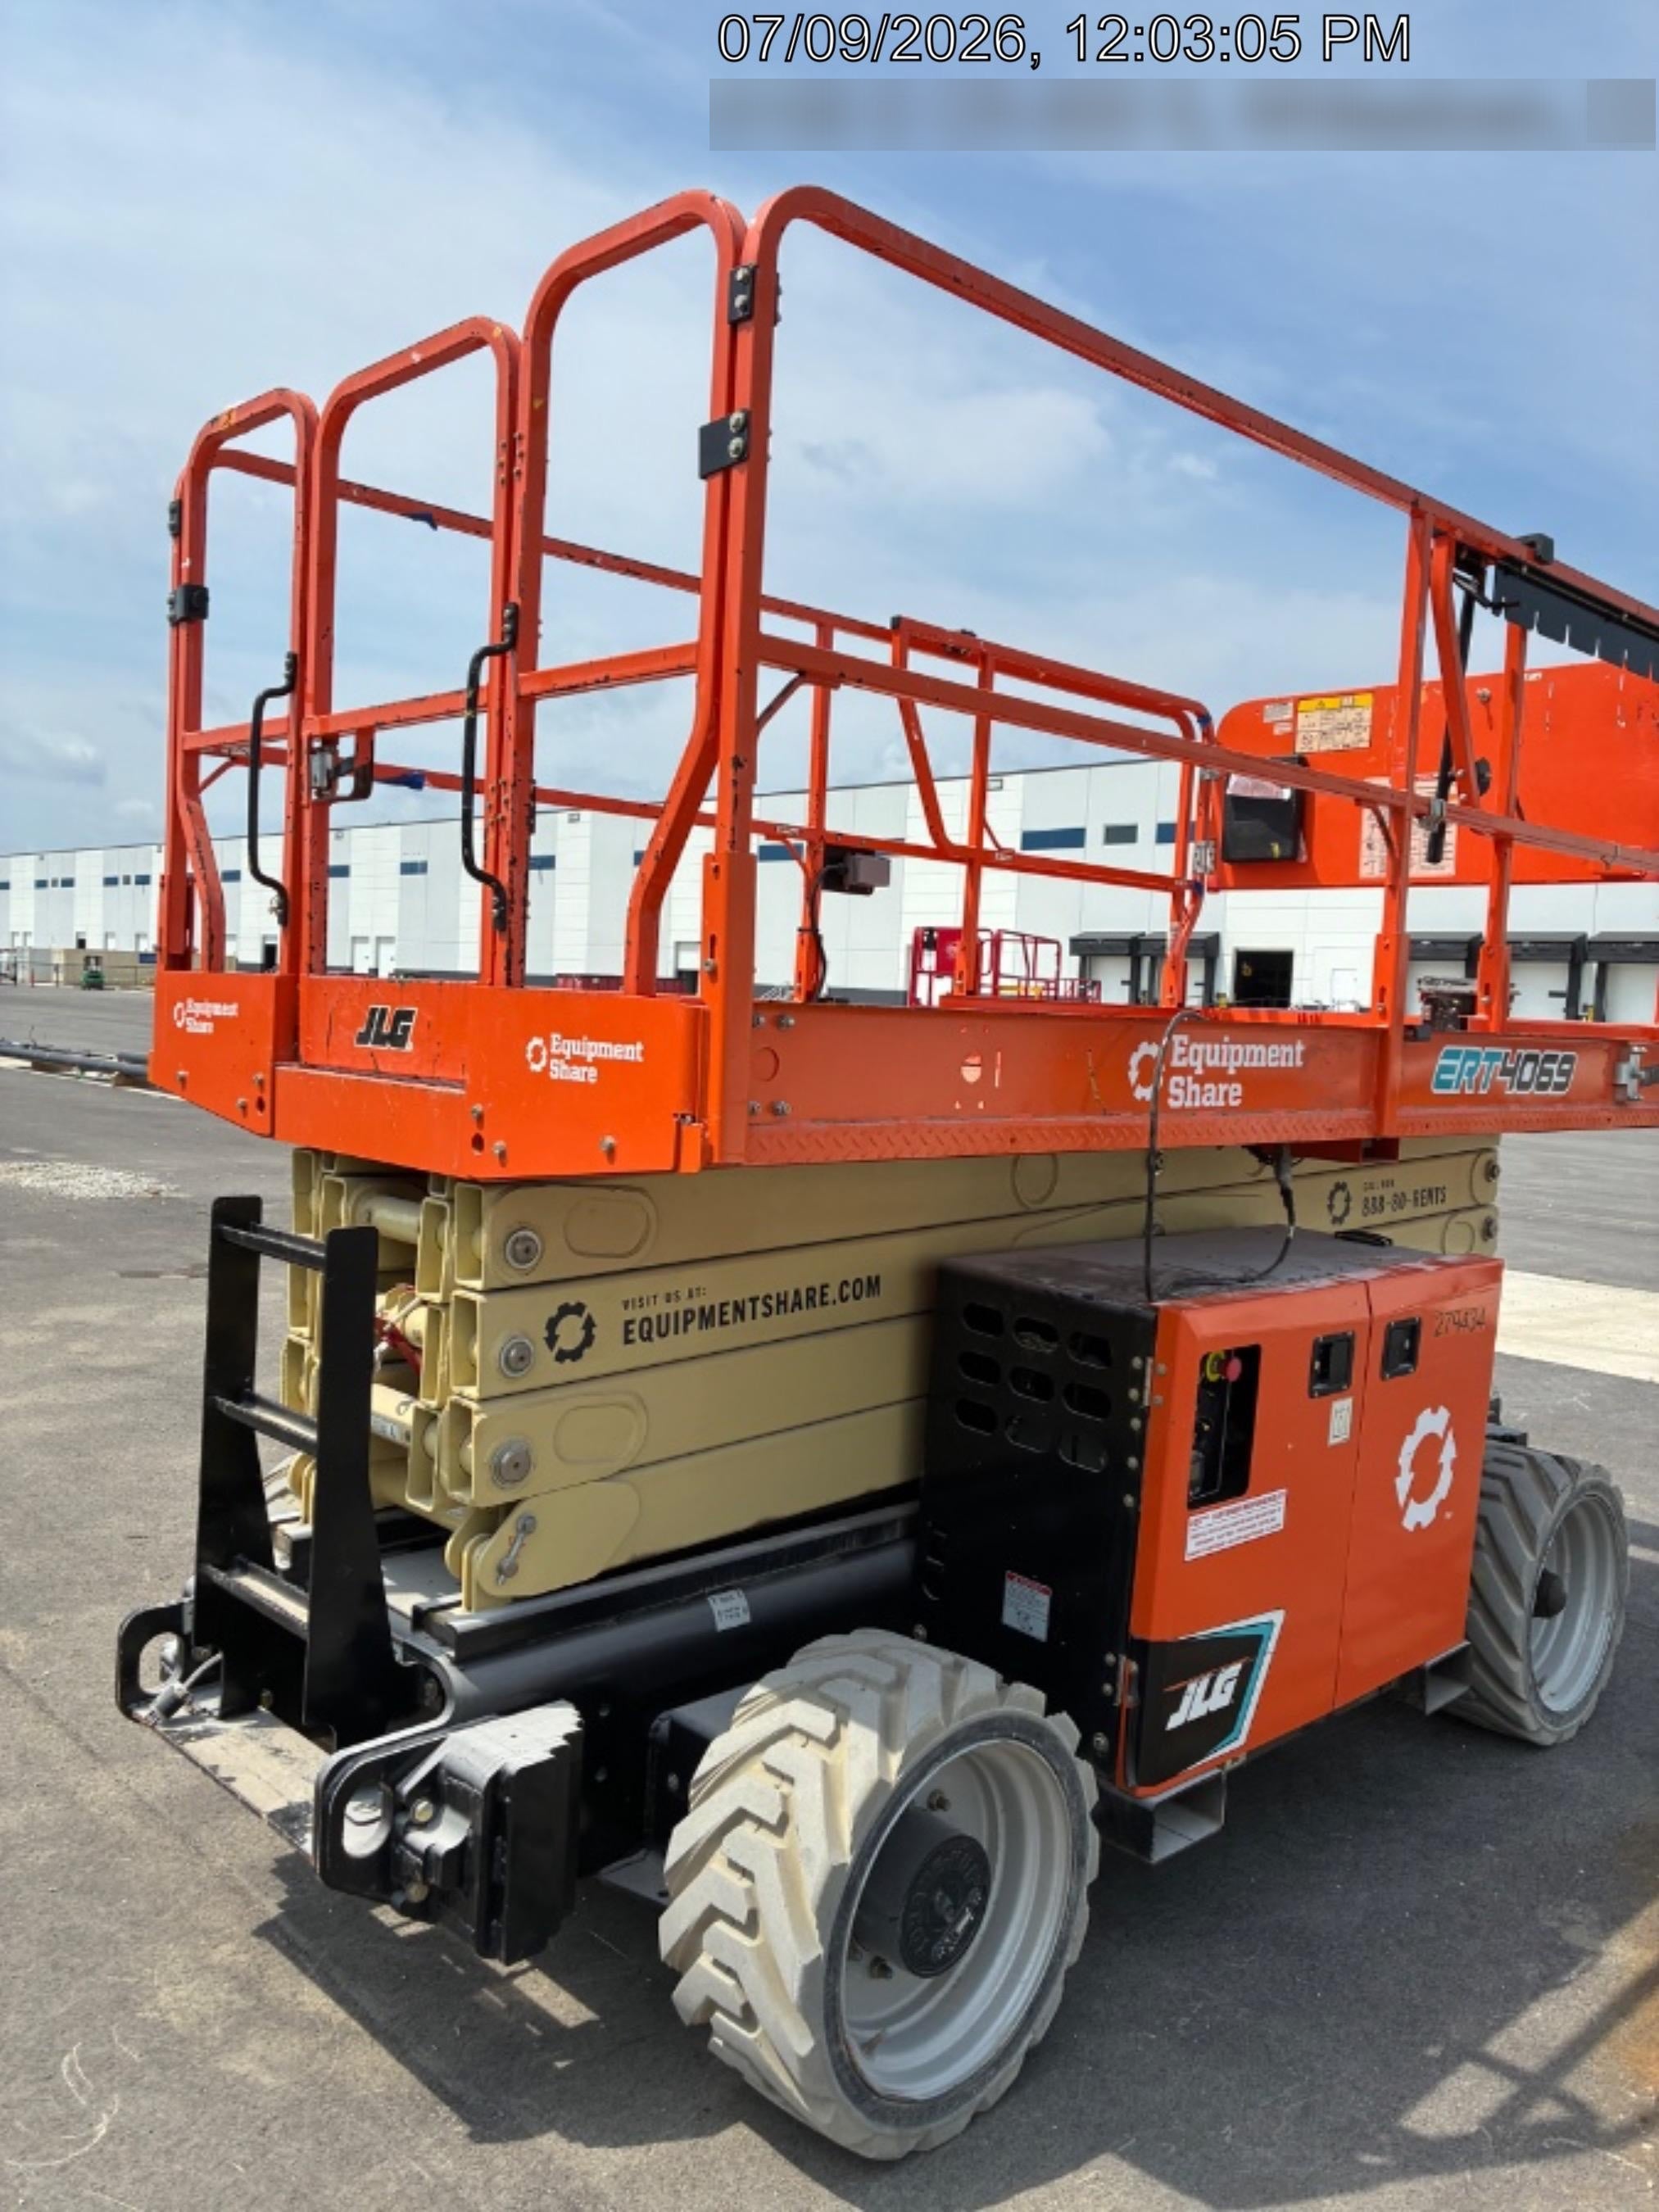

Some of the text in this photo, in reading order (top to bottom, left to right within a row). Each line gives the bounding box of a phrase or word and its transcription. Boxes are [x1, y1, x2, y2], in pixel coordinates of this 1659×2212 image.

[186, 997, 238, 1018] Equipment
[186, 1017, 214, 1034] Share
[354, 1004, 418, 1052] JLG
[550, 1032, 644, 1063] Equipment
[1170, 1035, 1305, 1074] Equipment
[550, 1058, 598, 1084] Share
[1431, 1045, 1578, 1095] ERT4069
[1167, 1076, 1242, 1108] Share
[622, 1294, 658, 1311] VISIT
[664, 1290, 681, 1303] US
[623, 1275, 881, 1345] EQUIPMENTSHARE.COM
[1165, 1663, 1242, 1731] JLG
